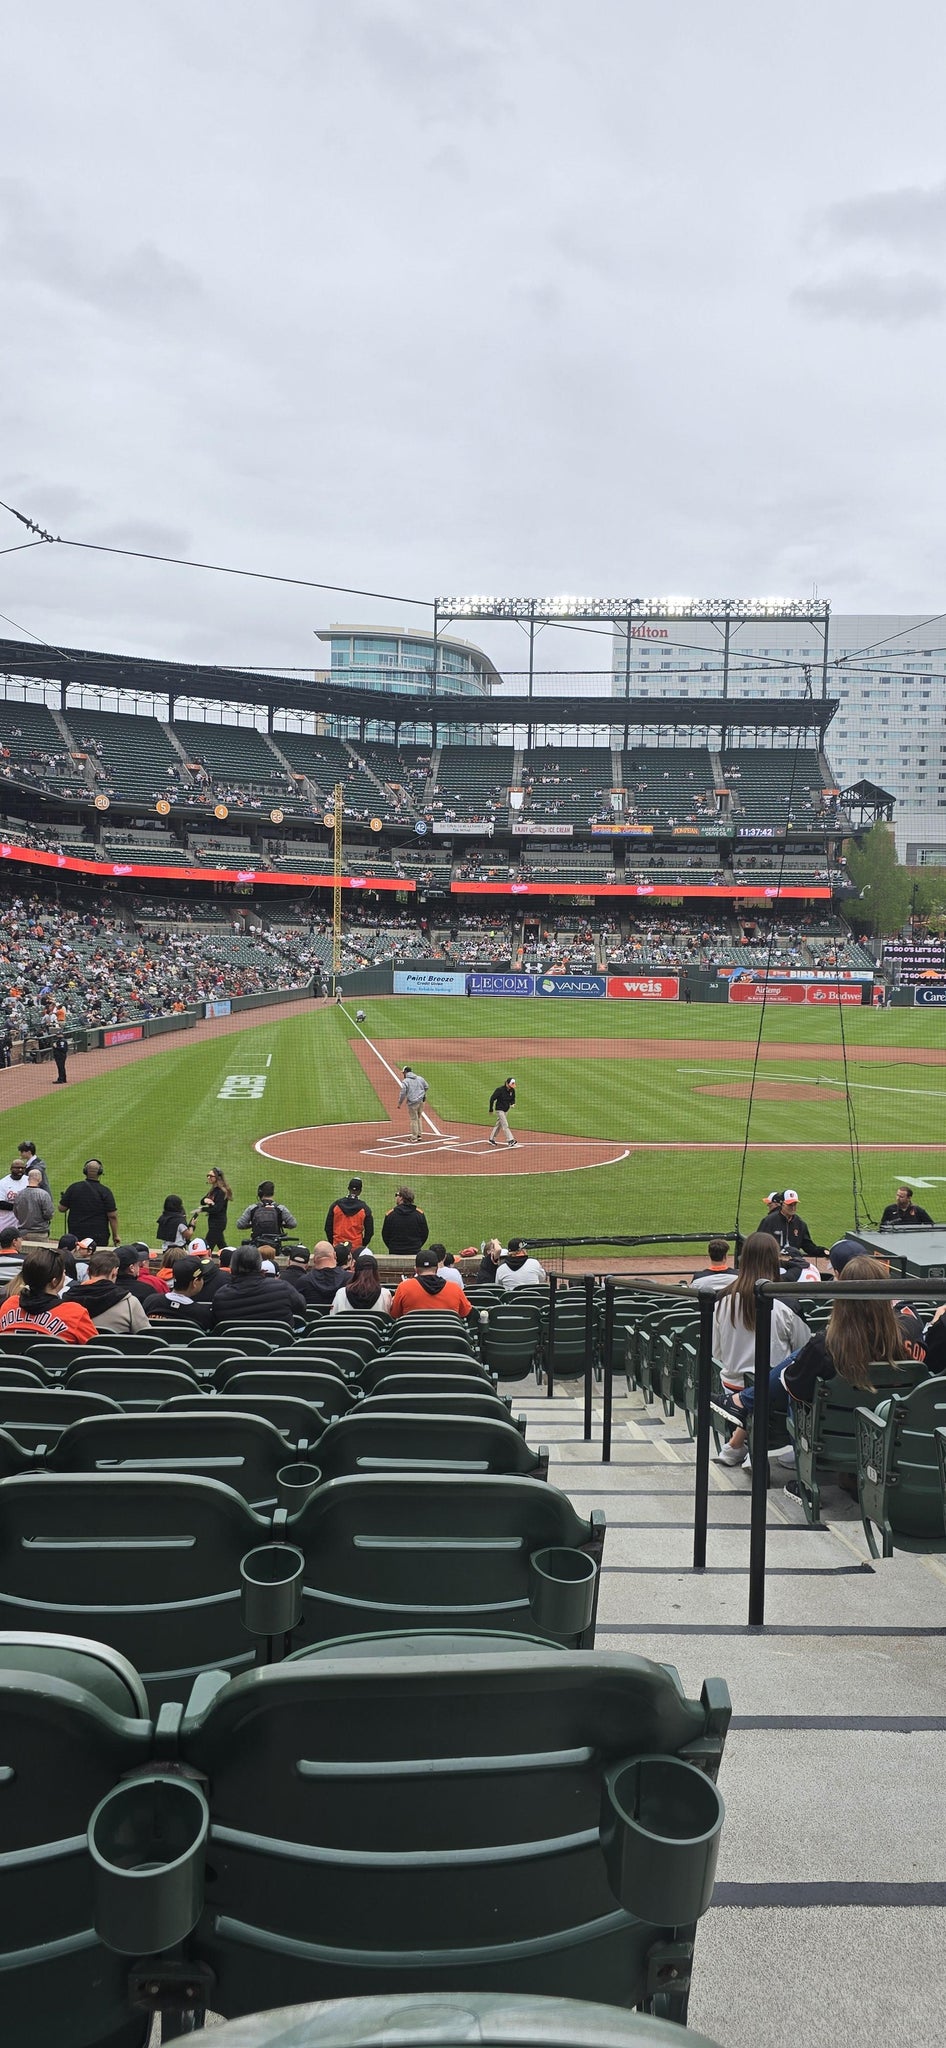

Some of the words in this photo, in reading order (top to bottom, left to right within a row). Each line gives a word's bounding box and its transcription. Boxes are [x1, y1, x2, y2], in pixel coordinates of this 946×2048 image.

[739, 828, 773, 837] 11:37:42
[790, 970, 815, 978] BIRD
[471, 977, 528, 989] LECOM
[555, 982, 600, 991] VANDA
[623, 980, 662, 993] weis
[923, 990, 946, 1002] Care
